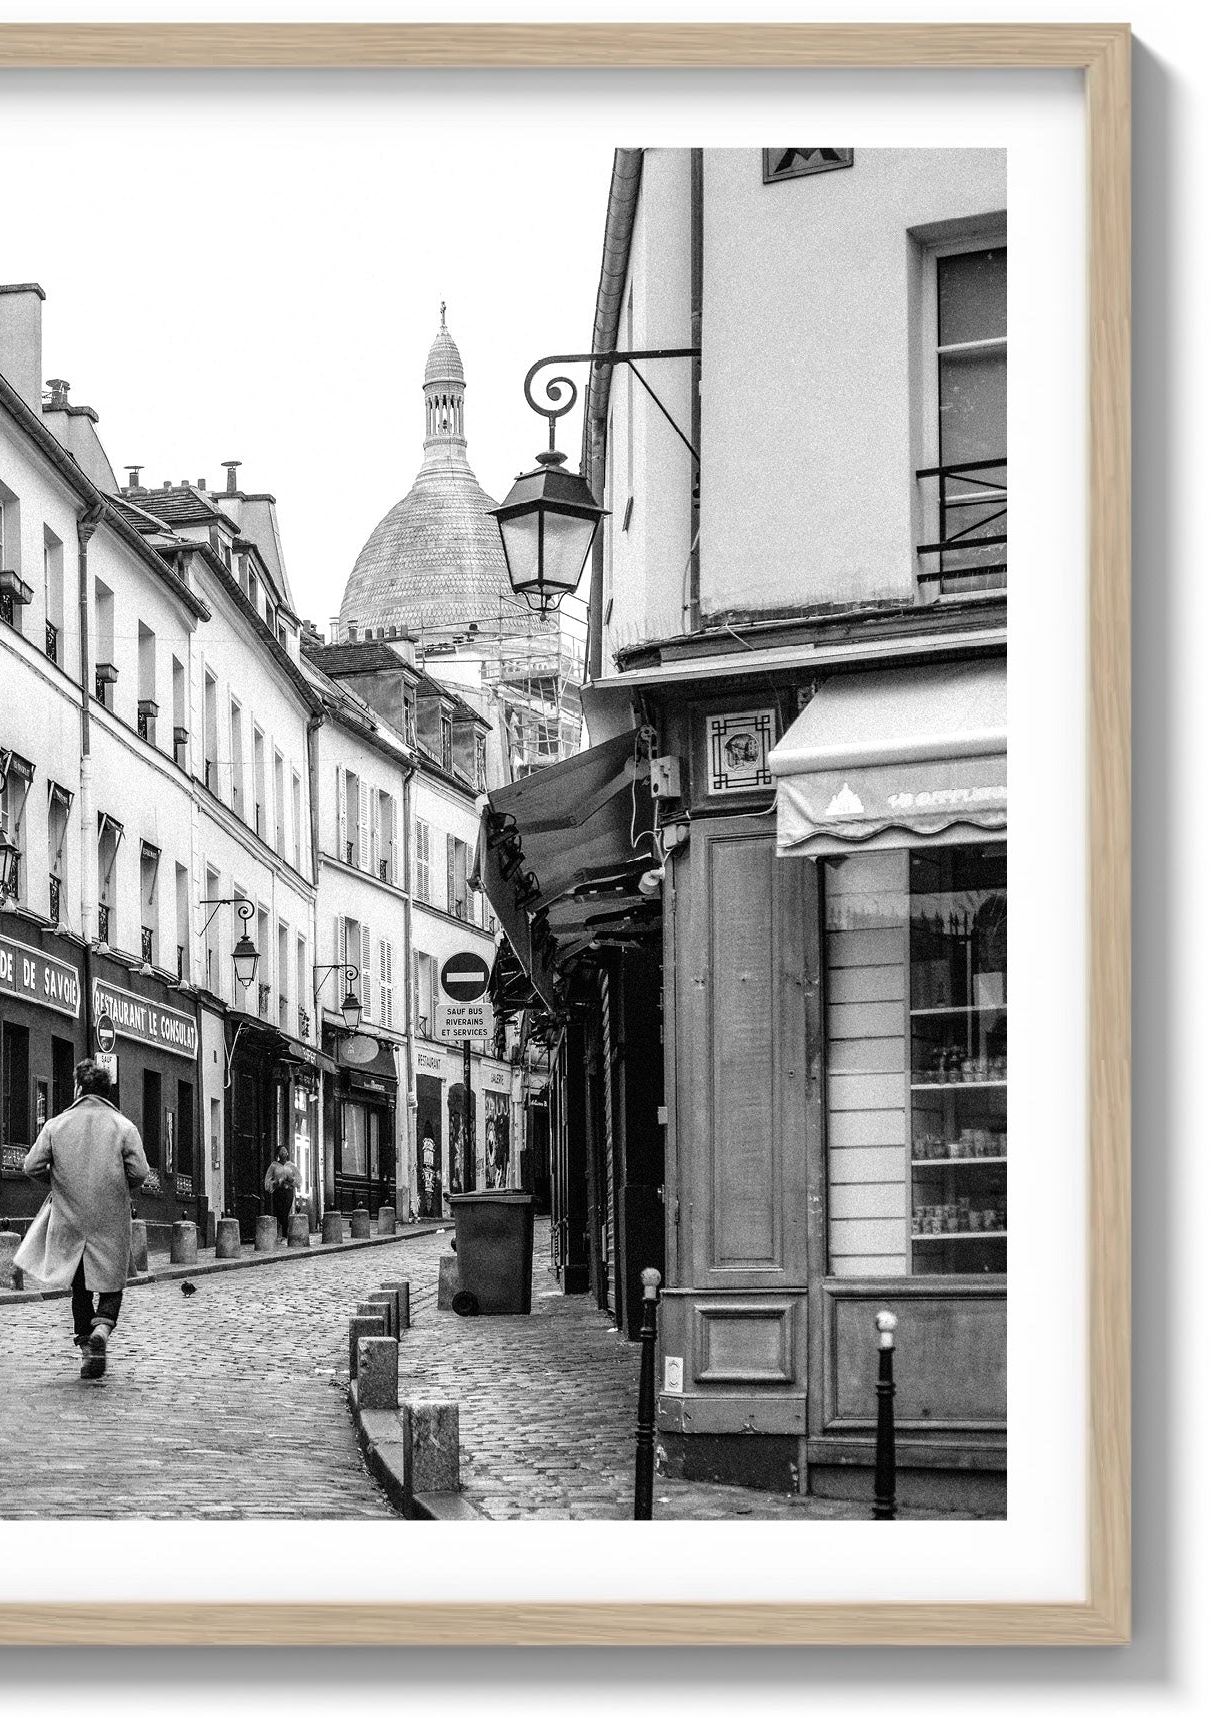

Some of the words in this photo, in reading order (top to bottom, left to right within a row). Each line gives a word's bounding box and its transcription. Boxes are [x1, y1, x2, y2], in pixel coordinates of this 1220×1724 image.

[23, 957, 36, 990] DE
[44, 967, 78, 1005] SAVOIE
[94, 990, 147, 1031] RESTAURANT
[148, 1008, 158, 1036] LE
[161, 1015, 196, 1050] CONSULAT
[445, 1018, 484, 1026] RIVERAINS
[453, 1028, 488, 1036] SERVICES
